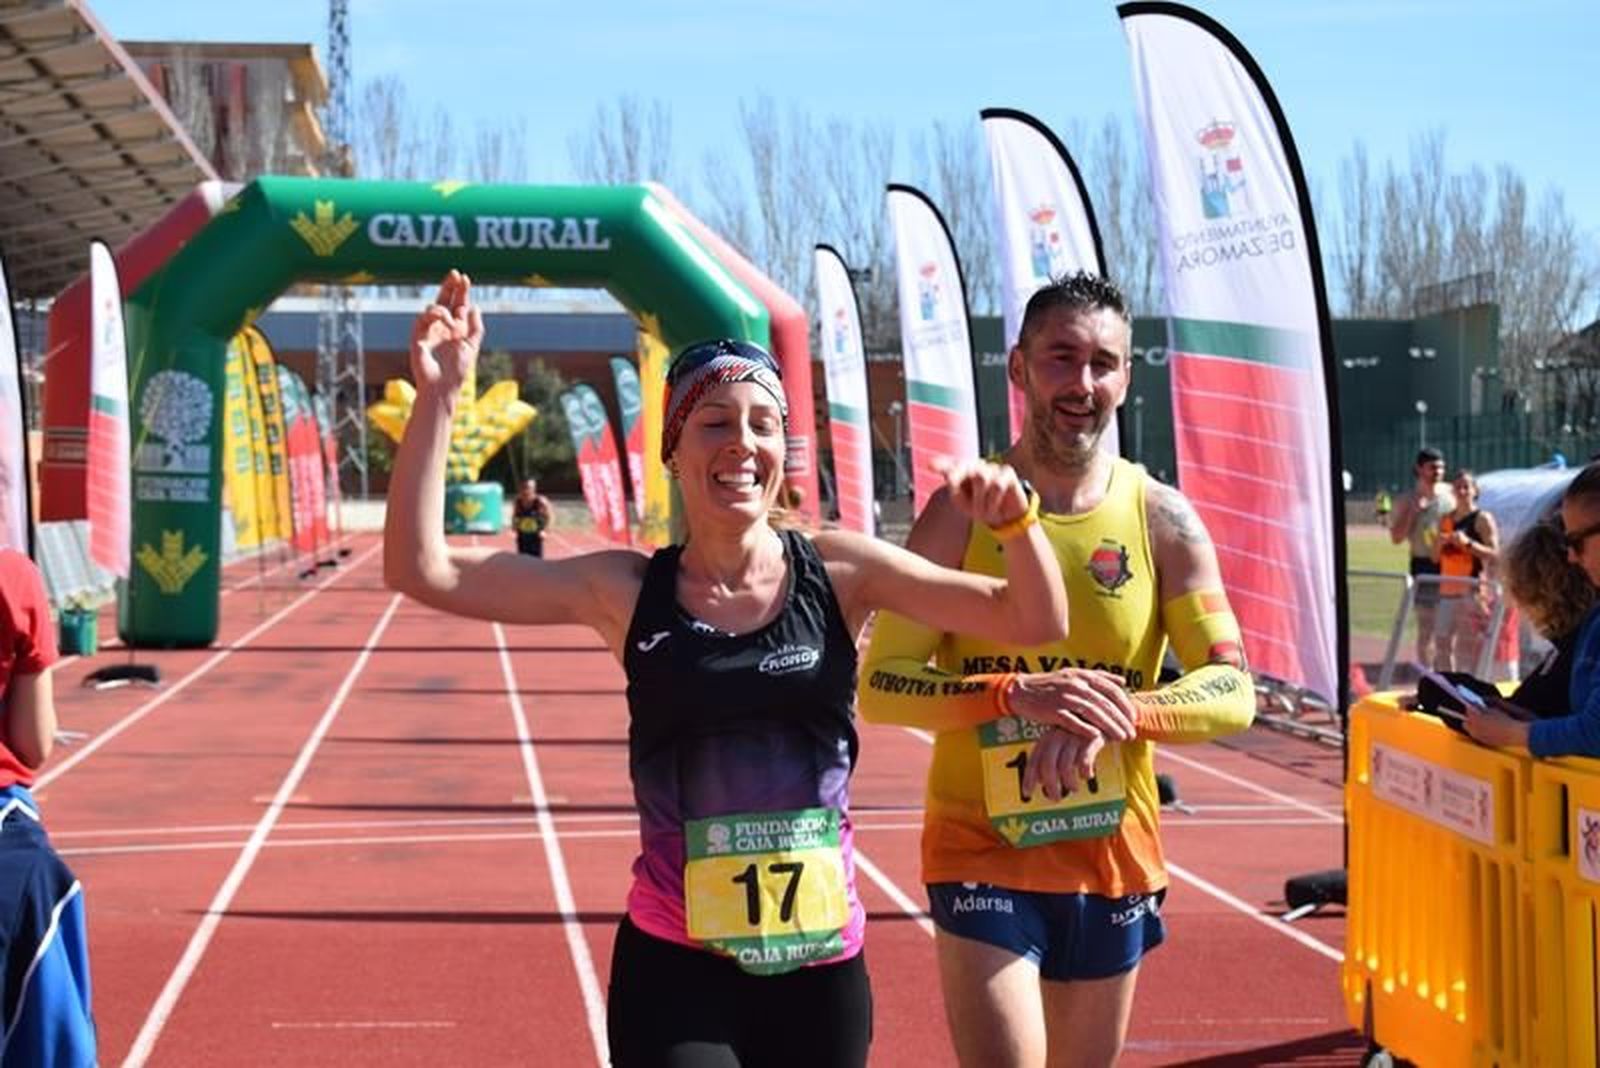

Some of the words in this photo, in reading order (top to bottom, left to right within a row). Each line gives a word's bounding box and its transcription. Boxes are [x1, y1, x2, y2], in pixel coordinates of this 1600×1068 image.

[367, 212, 464, 248] CAJA
[475, 216, 609, 249] RURAL
[963, 656, 1029, 675] MESA
[1072, 810, 1120, 831] RURAL
[732, 862, 804, 926] 17
[953, 895, 1014, 914] Adarsa
